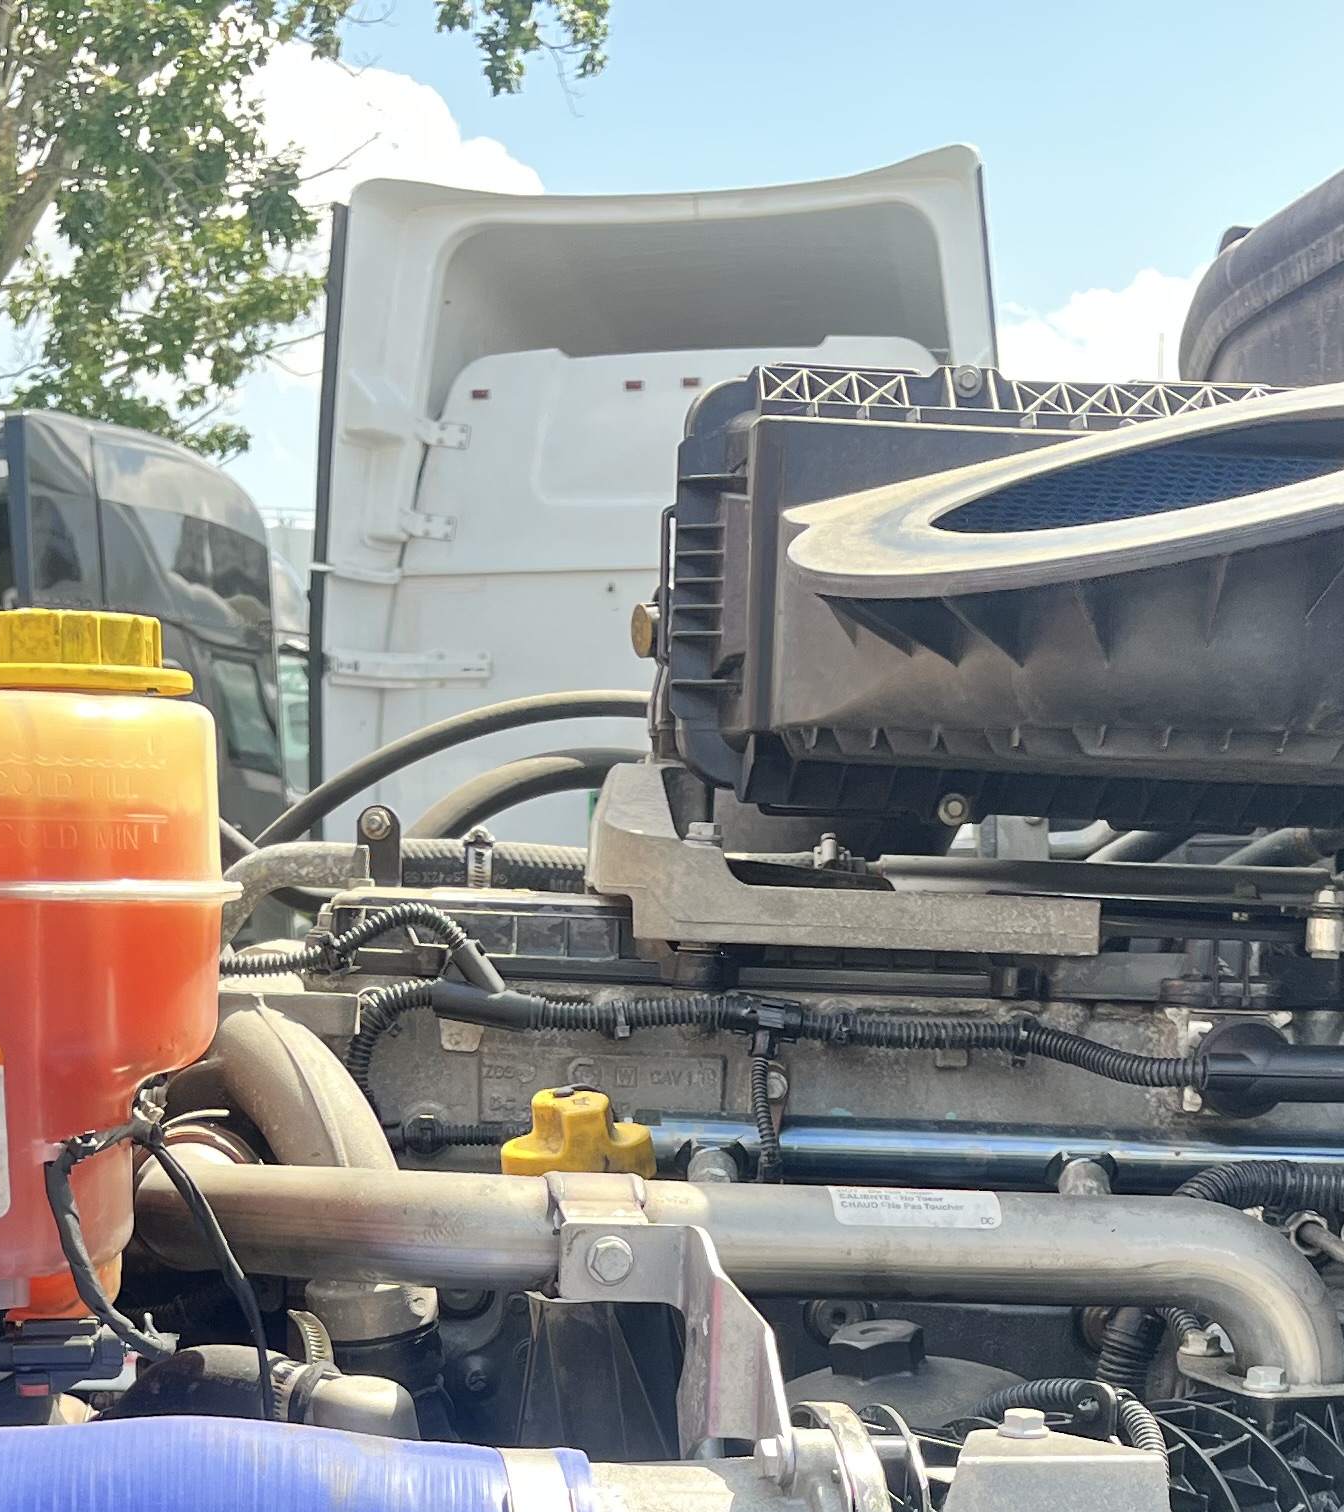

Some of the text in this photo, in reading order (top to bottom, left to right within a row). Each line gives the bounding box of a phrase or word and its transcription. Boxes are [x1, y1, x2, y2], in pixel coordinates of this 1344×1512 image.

[90, 773, 139, 799] FILL
[95, 824, 138, 850] MIN
[839, 1193, 890, 1201] CALIENTE
[841, 1201, 878, 1209] CHAUD
[925, 1203, 964, 1212] Toucher
[981, 1217, 994, 1226] DC
